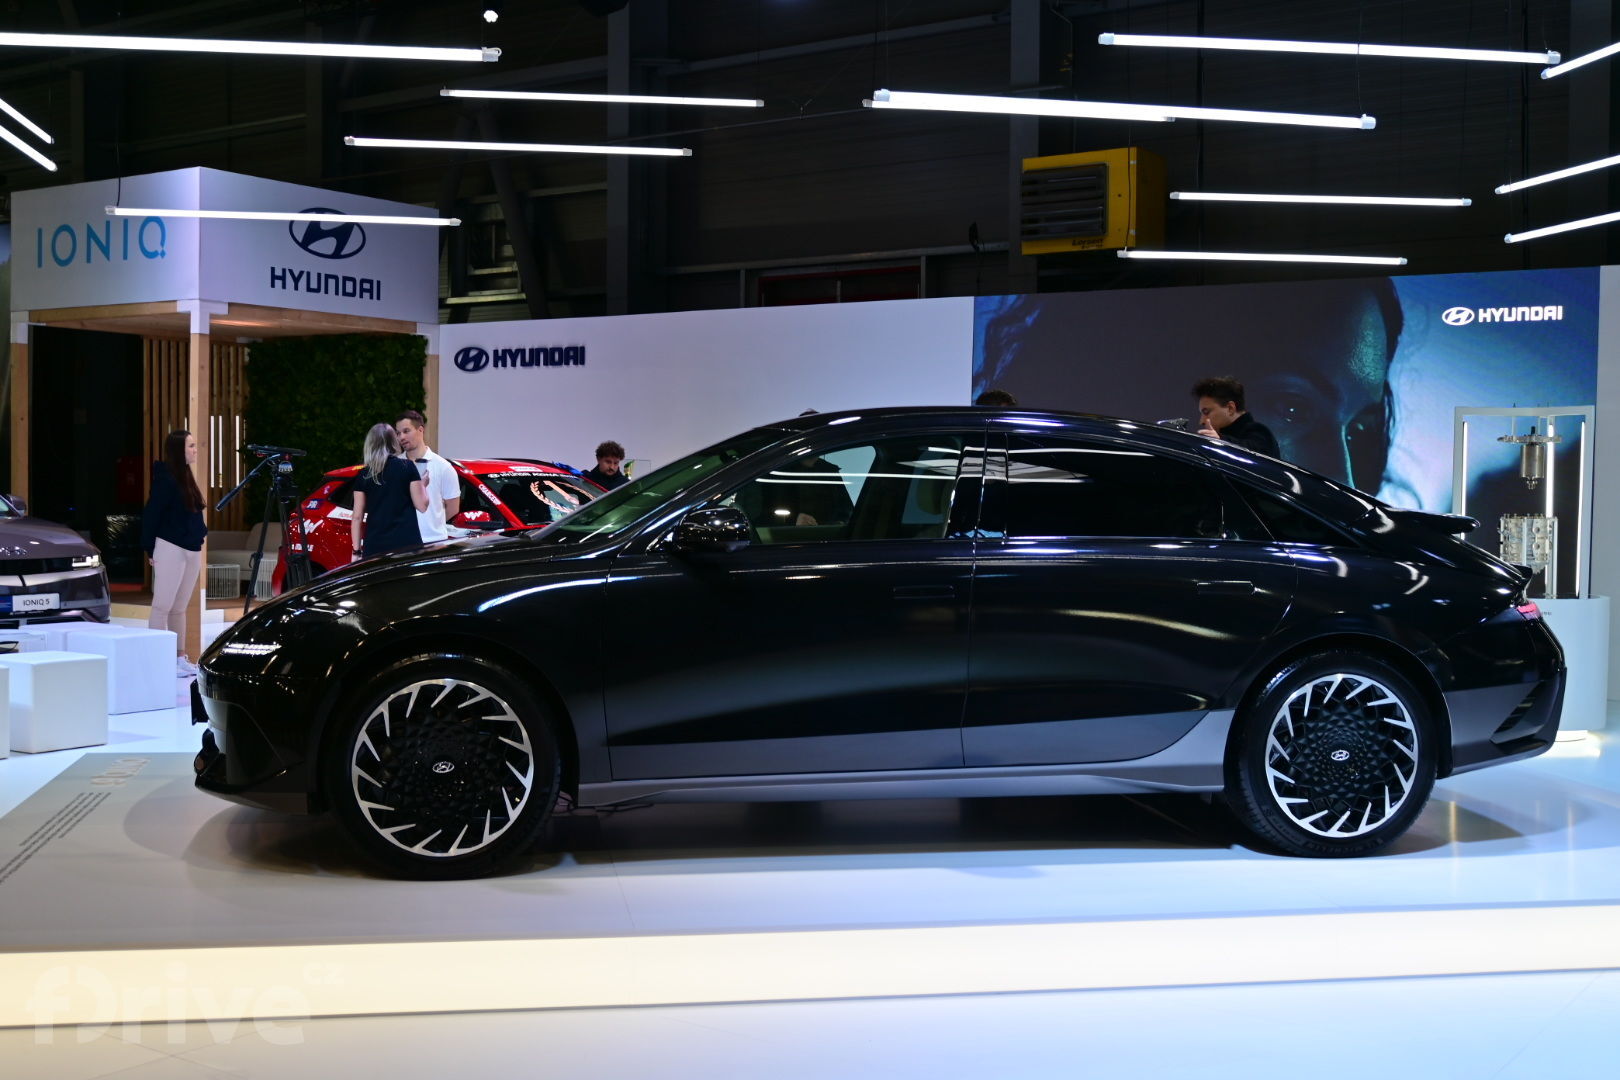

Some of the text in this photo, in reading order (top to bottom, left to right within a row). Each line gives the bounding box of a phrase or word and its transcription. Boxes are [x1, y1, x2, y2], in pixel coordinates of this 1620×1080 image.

[37, 216, 167, 268] IONIQ
[270, 266, 382, 301] HYUNDAI
[1478, 305, 1564, 323] HYUNDAI
[492, 345, 586, 368] HYUNDAI
